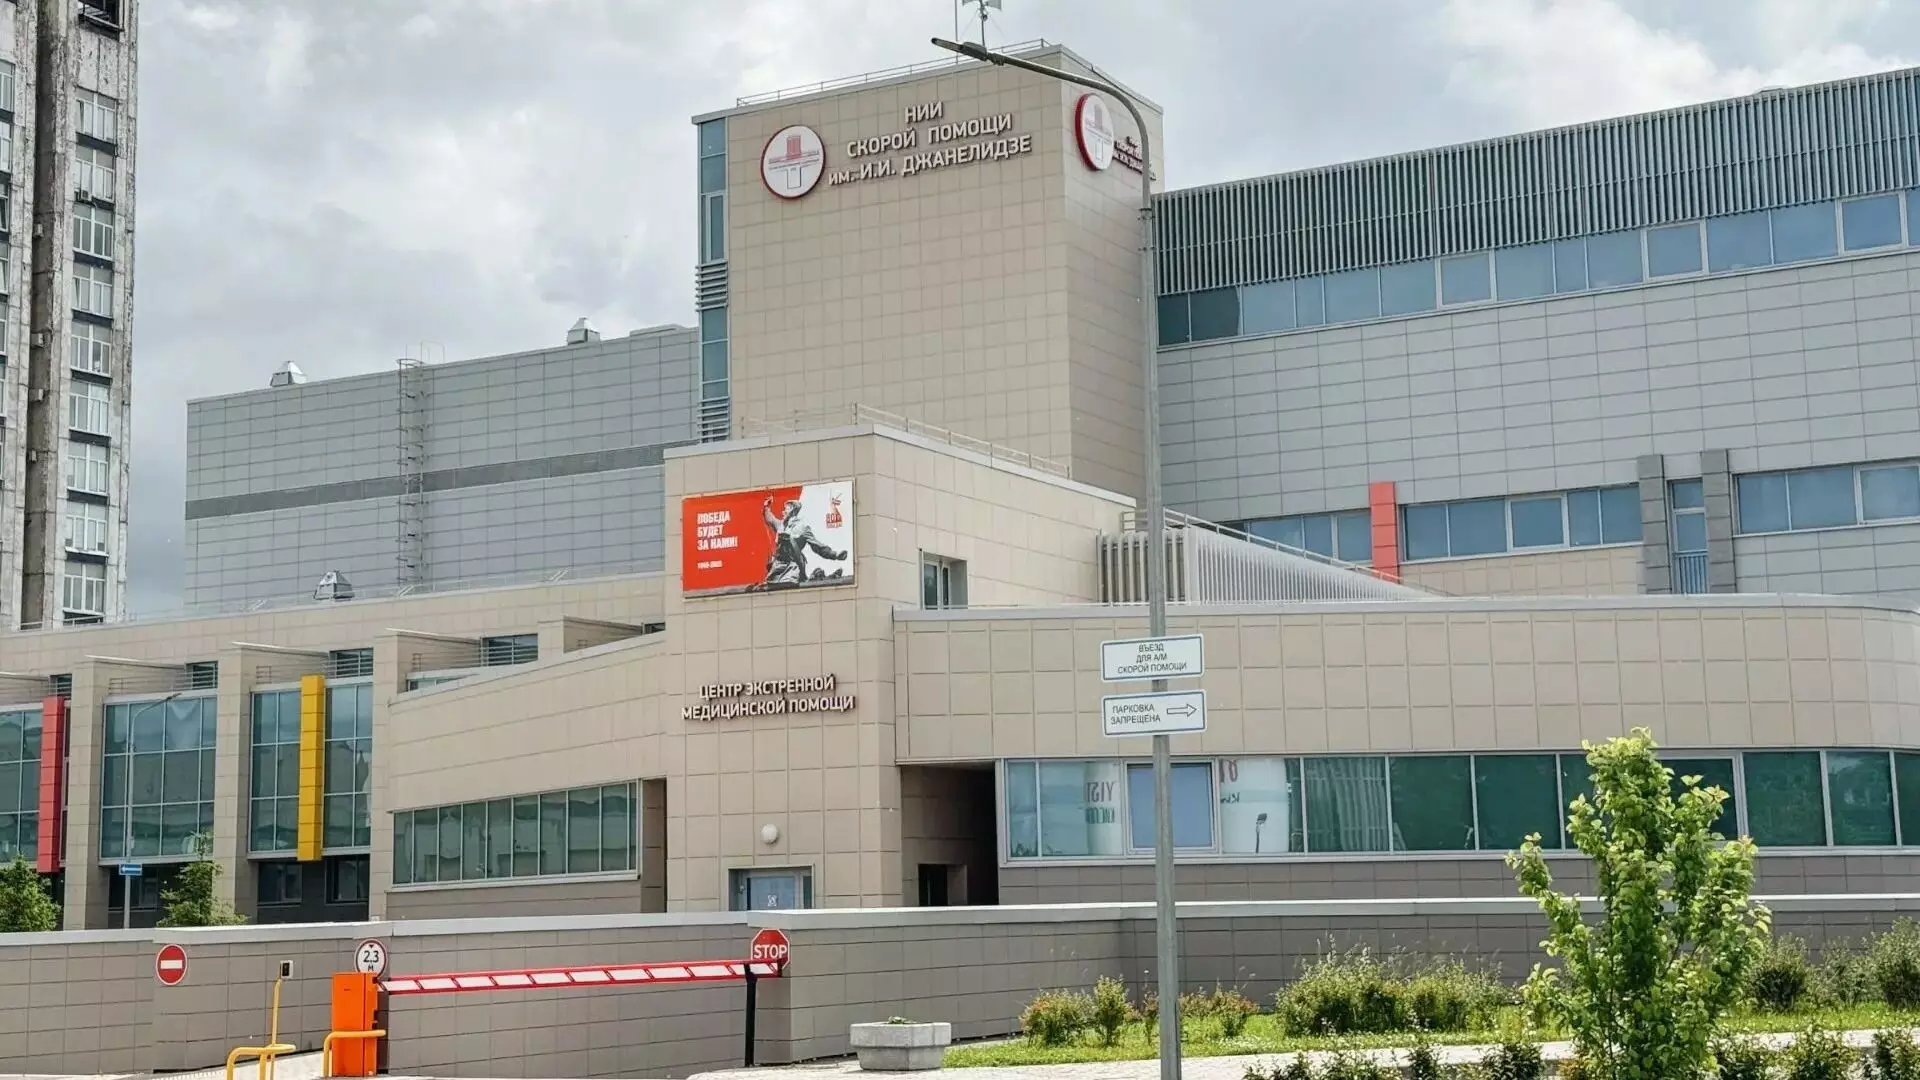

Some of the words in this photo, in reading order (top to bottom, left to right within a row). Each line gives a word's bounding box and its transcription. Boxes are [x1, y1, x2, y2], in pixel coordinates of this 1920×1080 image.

[904, 101, 944, 124] НИИ
[847, 127, 917, 157] СКОРОЙ
[928, 113, 1013, 145] ПОМОЩИ
[828, 170, 855, 186] им.
[859, 160, 896, 180] И.И.
[901, 135, 1032, 177] ДЖАНЕЛИДЗЕ
[697, 511, 731, 525] ПОБЕДА
[697, 525, 723, 538] БУДЕТ
[697, 539, 710, 551] ЗА
[710, 537, 738, 550] НАМИ!
[1138, 643, 1164, 653] ВЪЕЗД
[1136, 654, 1152, 664] ДЛЯ
[1153, 653, 1168, 662] А/М
[1117, 664, 1149, 674] СКОРОЙ
[1150, 662, 1187, 672] ПОМОЩИ
[699, 683, 744, 701] ЦЕНТР
[745, 673, 835, 697] ЭКСТРЕННОЙ
[681, 697, 787, 721] МЕДИЦИНСКОЙ
[788, 695, 855, 713] ПОМОЩИ
[1112, 704, 1155, 713] ПАРКОВКА
[1111, 714, 1161, 725] ЗАПРЕЩЕНА
[753, 944, 787, 959] STOP
